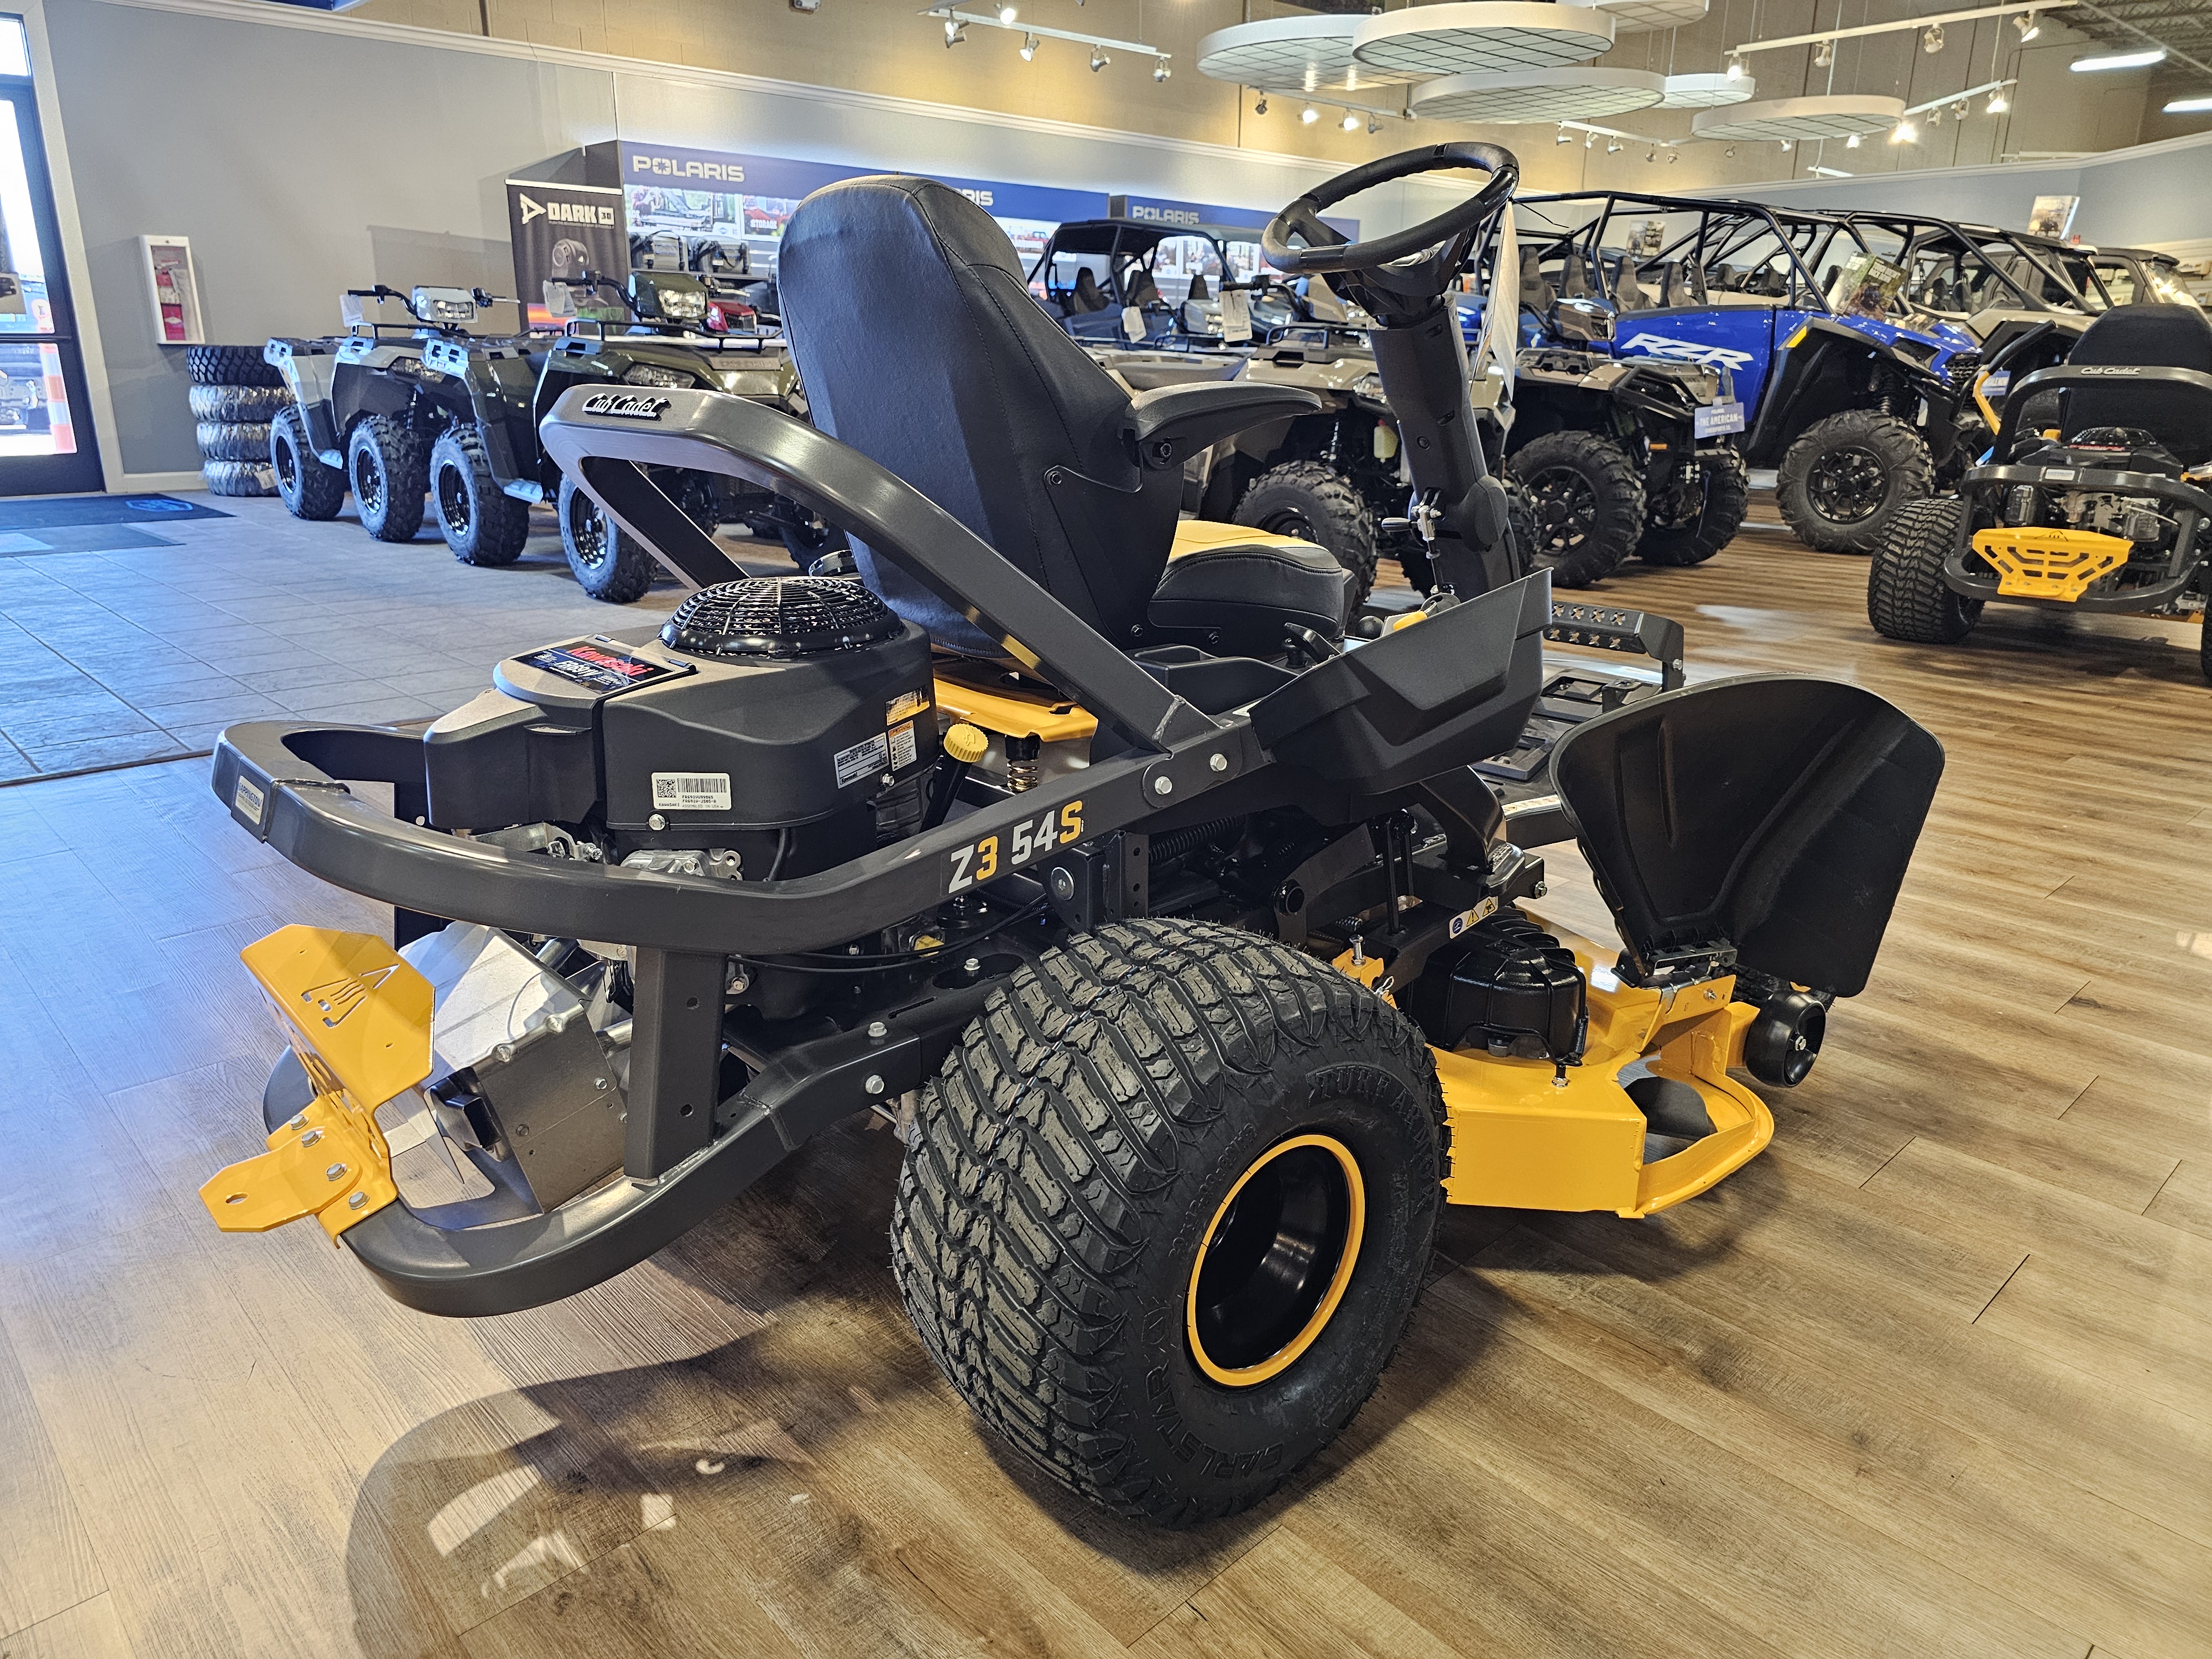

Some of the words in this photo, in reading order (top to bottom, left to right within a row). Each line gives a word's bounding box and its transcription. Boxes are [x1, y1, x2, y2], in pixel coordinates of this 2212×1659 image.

[633, 155, 745, 182] POLARIS
[547, 202, 597, 224] DARK
[1132, 205, 1199, 225] POLARIS
[1621, 332, 1754, 371] RZR
[582, 393, 622, 414] Cub
[611, 394, 669, 418] Cadet
[1710, 413, 1738, 425] AMERICAN
[556, 660, 603, 677] FR691V
[566, 646, 655, 676] Kawasaki
[948, 836, 998, 894] Z3
[1011, 800, 1083, 865] 54S
